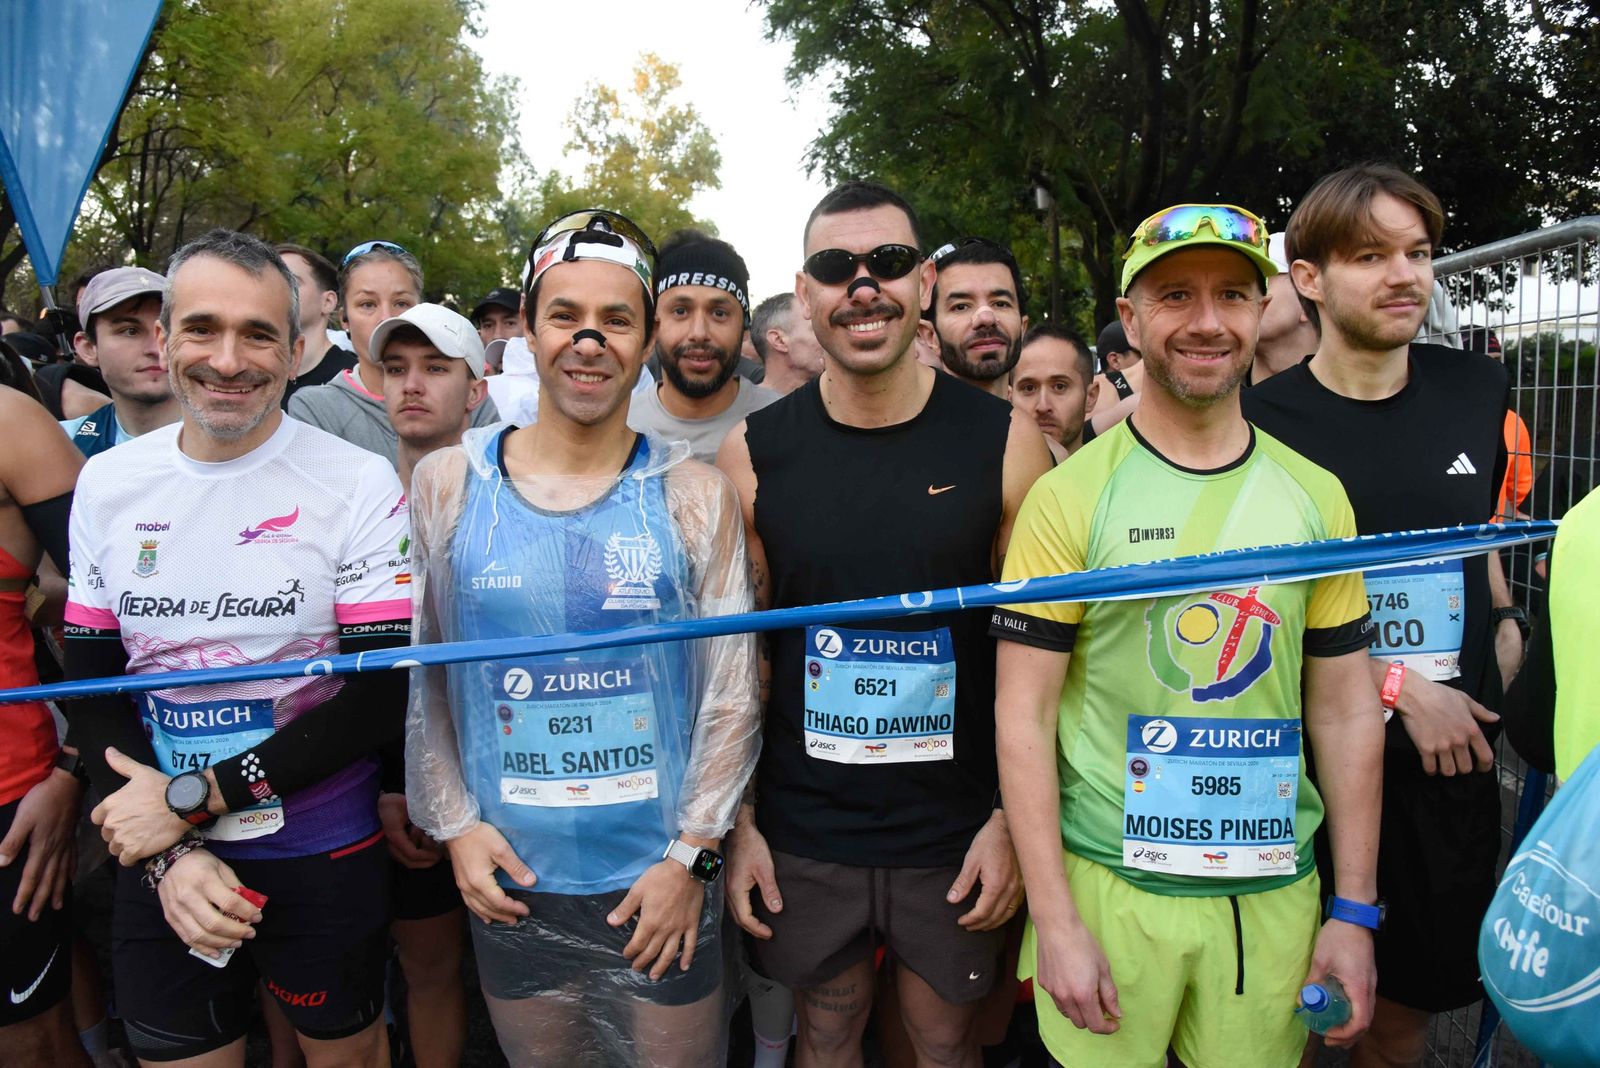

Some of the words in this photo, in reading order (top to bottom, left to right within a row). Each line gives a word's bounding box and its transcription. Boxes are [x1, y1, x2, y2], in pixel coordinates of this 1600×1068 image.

[135, 521, 171, 533] mobel
[1141, 527, 1175, 541] INVERSE
[471, 575, 522, 590] STADIO
[117, 591, 185, 617] SIERRA
[189, 600, 209, 614] DE
[207, 592, 297, 621] SEGURA
[1216, 593, 1240, 607] CLUB
[64, 625, 101, 635] PORT
[1004, 616, 1029, 632] VALLE
[852, 638, 938, 657] ZURICH
[543, 669, 632, 692] ZURICH
[854, 678, 896, 697] 6521
[163, 707, 251, 729] ZURICH
[548, 715, 593, 735] 6231
[806, 708, 869, 735] THIAGO
[875, 713, 951, 736] DAWINO
[818, 741, 837, 751] asics
[1189, 729, 1281, 748] ZURICH
[172, 750, 211, 770] 6747
[503, 751, 555, 775] ABEL
[561, 743, 655, 774] SANTOS
[518, 786, 537, 796] asics
[1191, 775, 1242, 796] 5985
[1126, 814, 1213, 841] MOISES
[1220, 817, 1295, 841] PINEDA
[1144, 850, 1168, 862] asics
